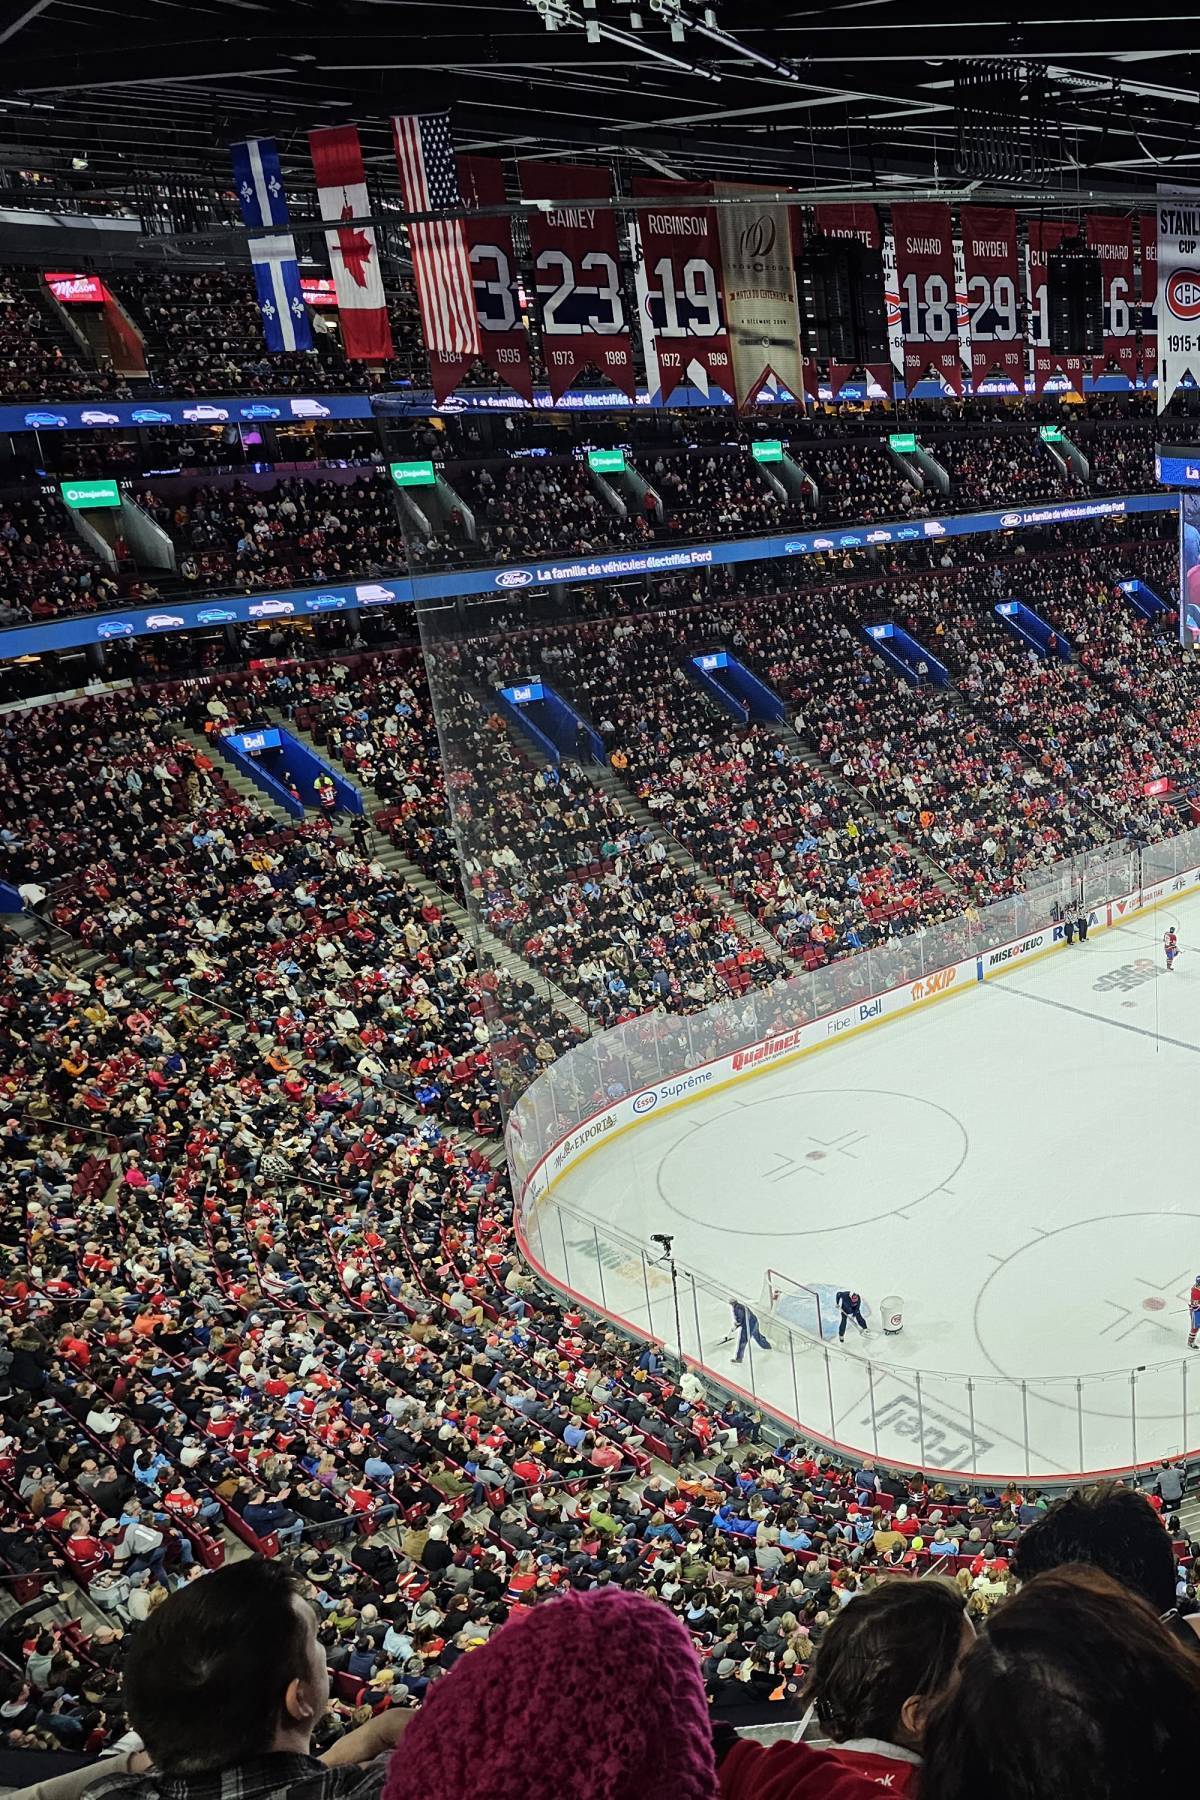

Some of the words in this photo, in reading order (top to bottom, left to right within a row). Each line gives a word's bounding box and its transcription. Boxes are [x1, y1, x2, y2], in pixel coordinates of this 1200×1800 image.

[547, 209, 595, 230] GAINEY
[648, 215, 708, 236] ROBINSON
[907, 237, 941, 256] SAVARD
[972, 240, 1008, 258] DRYDEN
[1179, 240, 1196, 254] CUP
[51, 279, 96, 298] Molson
[537, 250, 624, 335] 23
[654, 258, 721, 337] 19
[902, 273, 951, 342] 18
[967, 276, 1017, 341] 29
[438, 351, 463, 363] 1984
[496, 349, 521, 363] 1995
[552, 350, 574, 365] 1973
[605, 351, 627, 365] 1989
[708, 352, 728, 366] 1989
[973, 353, 986, 365] 1970
[1004, 352, 1019, 364] 1979
[1119, 347, 1132, 358] 1975
[660, 353, 681, 367] 1972
[905, 355, 921, 367] 1966
[941, 355, 955, 367] 1981
[1037, 359, 1050, 371] 1963
[1066, 358, 1080, 370] 1979
[487, 395, 522, 407] famille
[583, 393, 628, 406] électrifiés
[376, 465, 386, 474] 211
[435, 461, 445, 470] 212
[1186, 467, 1199, 480] La
[41, 485, 56, 494] 210
[120, 480, 133, 489] 211
[78, 489, 115, 499] Desjardins
[537, 570, 552, 581] La
[553, 566, 586, 580] famille
[587, 565, 602, 576] de
[602, 558, 646, 574] véhicules
[646, 554, 691, 568] électrifiés
[691, 551, 712, 562] Ford
[499, 571, 529, 586] Ford
[702, 656, 717, 668] Bell
[514, 688, 531, 700] Bell
[243, 735, 265, 749] Bell
[925, 967, 957, 993] SKIP
[827, 1017, 851, 1034] Fibe
[859, 998, 882, 1021] Bell
[732, 1030, 801, 1071] Qualinet
[660, 1071, 713, 1099] Suprême
